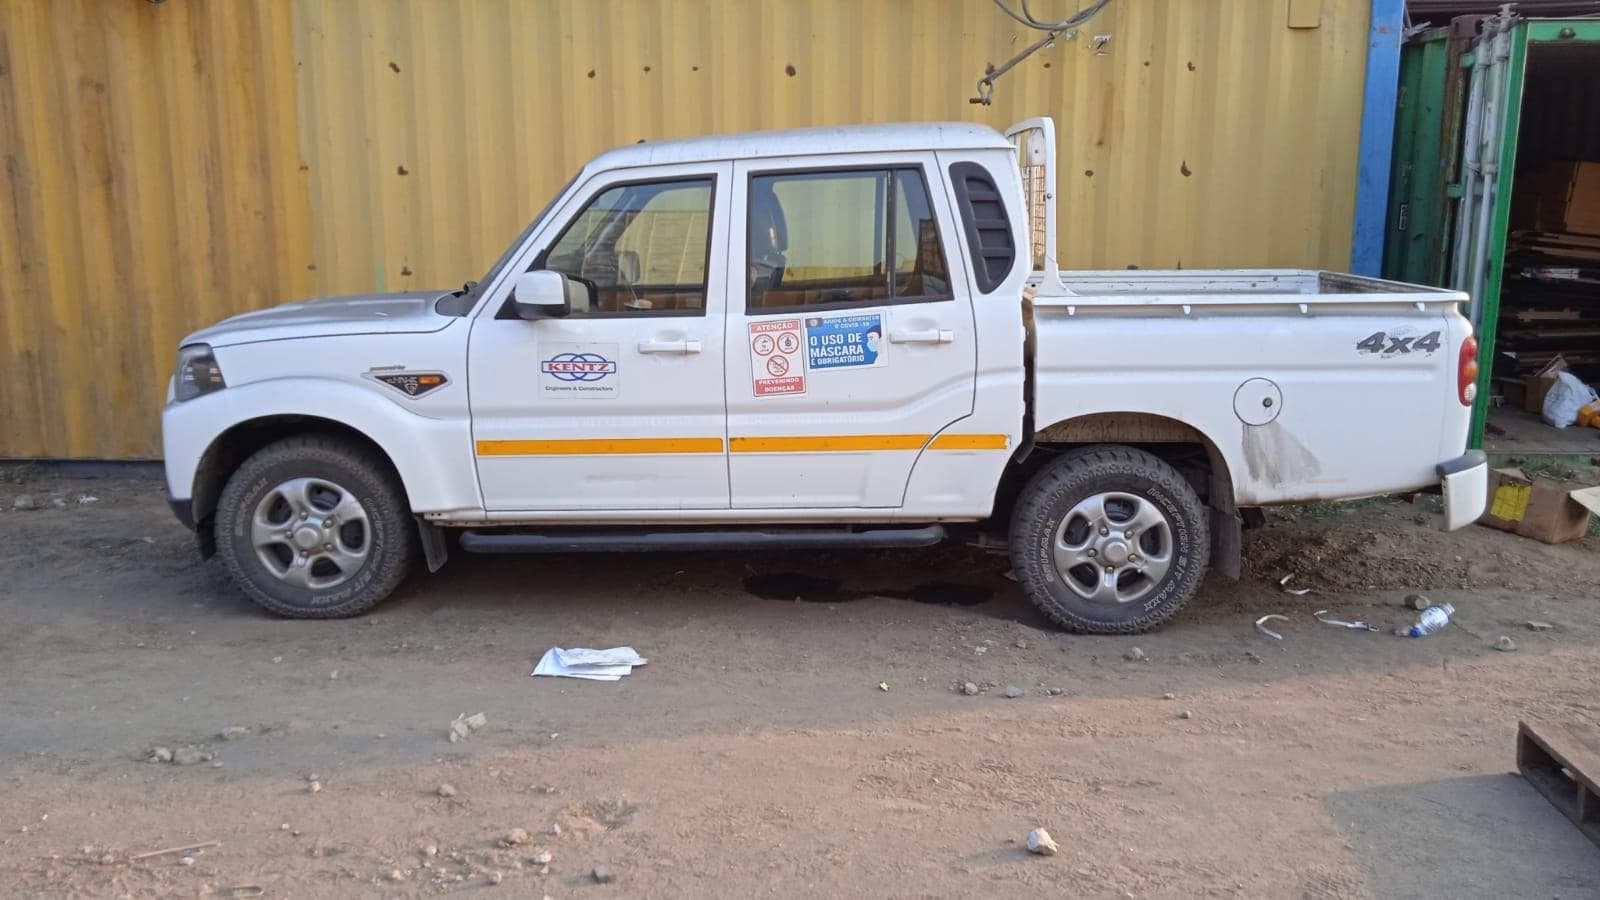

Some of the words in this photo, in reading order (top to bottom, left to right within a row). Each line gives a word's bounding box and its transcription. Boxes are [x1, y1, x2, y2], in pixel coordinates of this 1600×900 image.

[810, 335, 818, 346] O
[821, 333, 844, 345] USO
[847, 332, 863, 344] DE
[1356, 331, 1441, 353] 4x4
[810, 344, 864, 358] MÁSCARA
[817, 354, 865, 365] OBRIGATÓRIO
[548, 363, 609, 371] KENTZ
